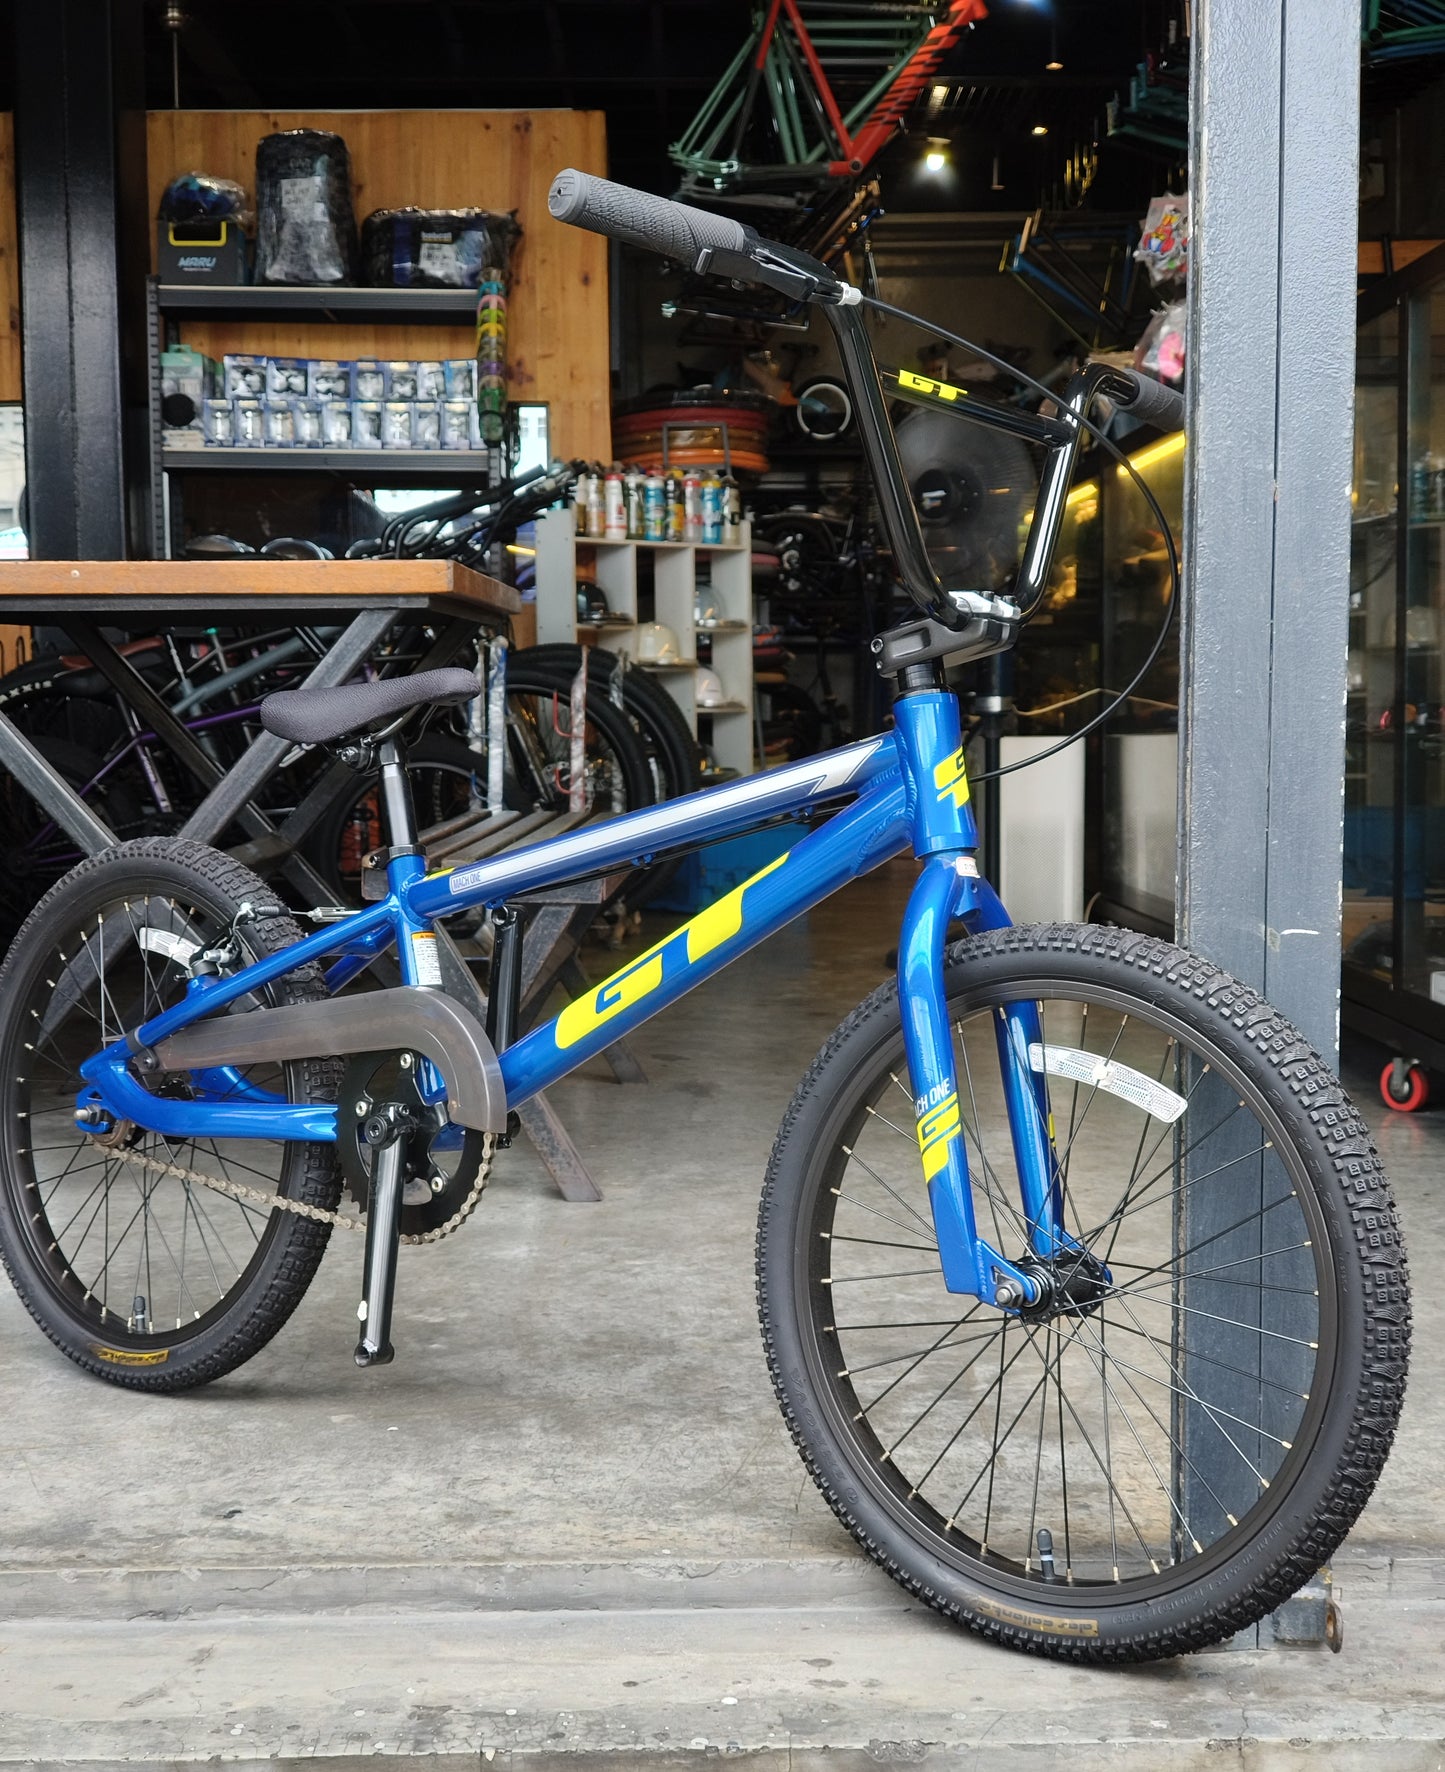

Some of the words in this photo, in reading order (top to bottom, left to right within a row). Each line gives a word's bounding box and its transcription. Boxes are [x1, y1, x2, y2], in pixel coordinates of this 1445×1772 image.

[178, 256, 217, 267] MARU
[899, 370, 968, 400] GT
[933, 746, 970, 809] GT
[453, 876, 470, 889] MACH
[470, 872, 480, 884] ONE
[555, 852, 790, 1049] GT
[915, 1094, 928, 1118] CH
[930, 1078, 950, 1105] ONE
[917, 1092, 961, 1184] GT
